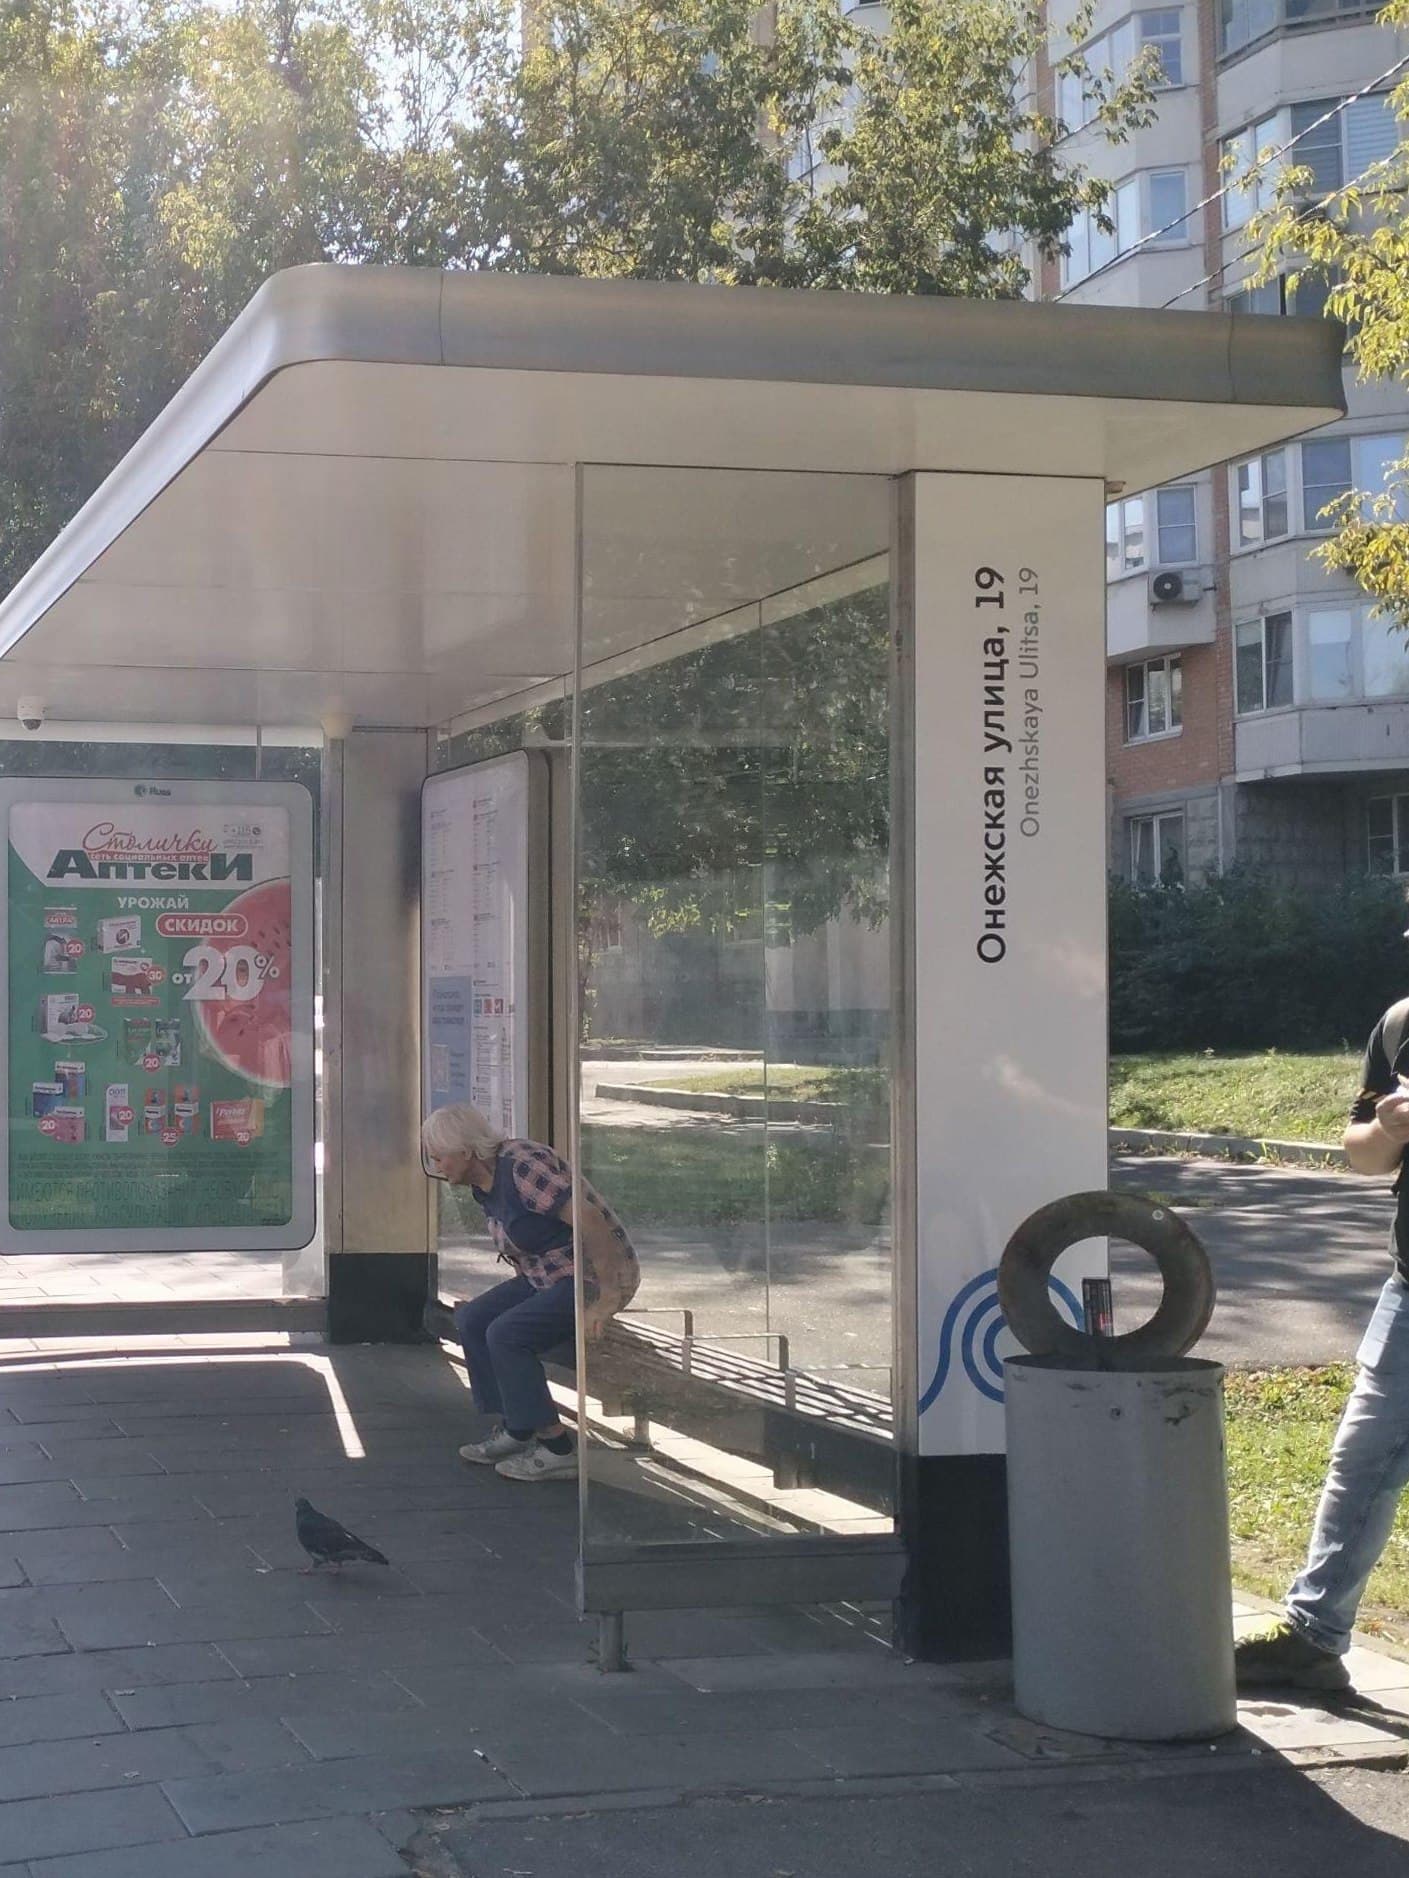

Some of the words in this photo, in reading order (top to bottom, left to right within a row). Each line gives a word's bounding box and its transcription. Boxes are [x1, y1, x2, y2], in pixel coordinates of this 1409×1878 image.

[974, 566, 1005, 609] 19
[1018, 567, 1039, 596] 19
[1018, 604, 1042, 679] Ulitsa,
[983, 625, 1012, 753] улица,
[1018, 688, 1044, 838] Onezhskaya
[82, 821, 218, 853] Столички
[90, 853, 112, 862] сеть
[114, 853, 178, 863] социальных
[976, 766, 1007, 964] Онежская
[117, 894, 190, 909] УРОЖАЙ
[164, 918, 239, 934] СКИДОК
[67, 943, 82, 954] 20
[148, 970, 163, 981] 30
[172, 973, 193, 985] от
[78, 1008, 93, 1018] 20
[144, 1057, 159, 1068] 20
[118, 1110, 133, 1120] 20
[40, 1119, 56, 1130] 20
[162, 1132, 177, 1143] 25
